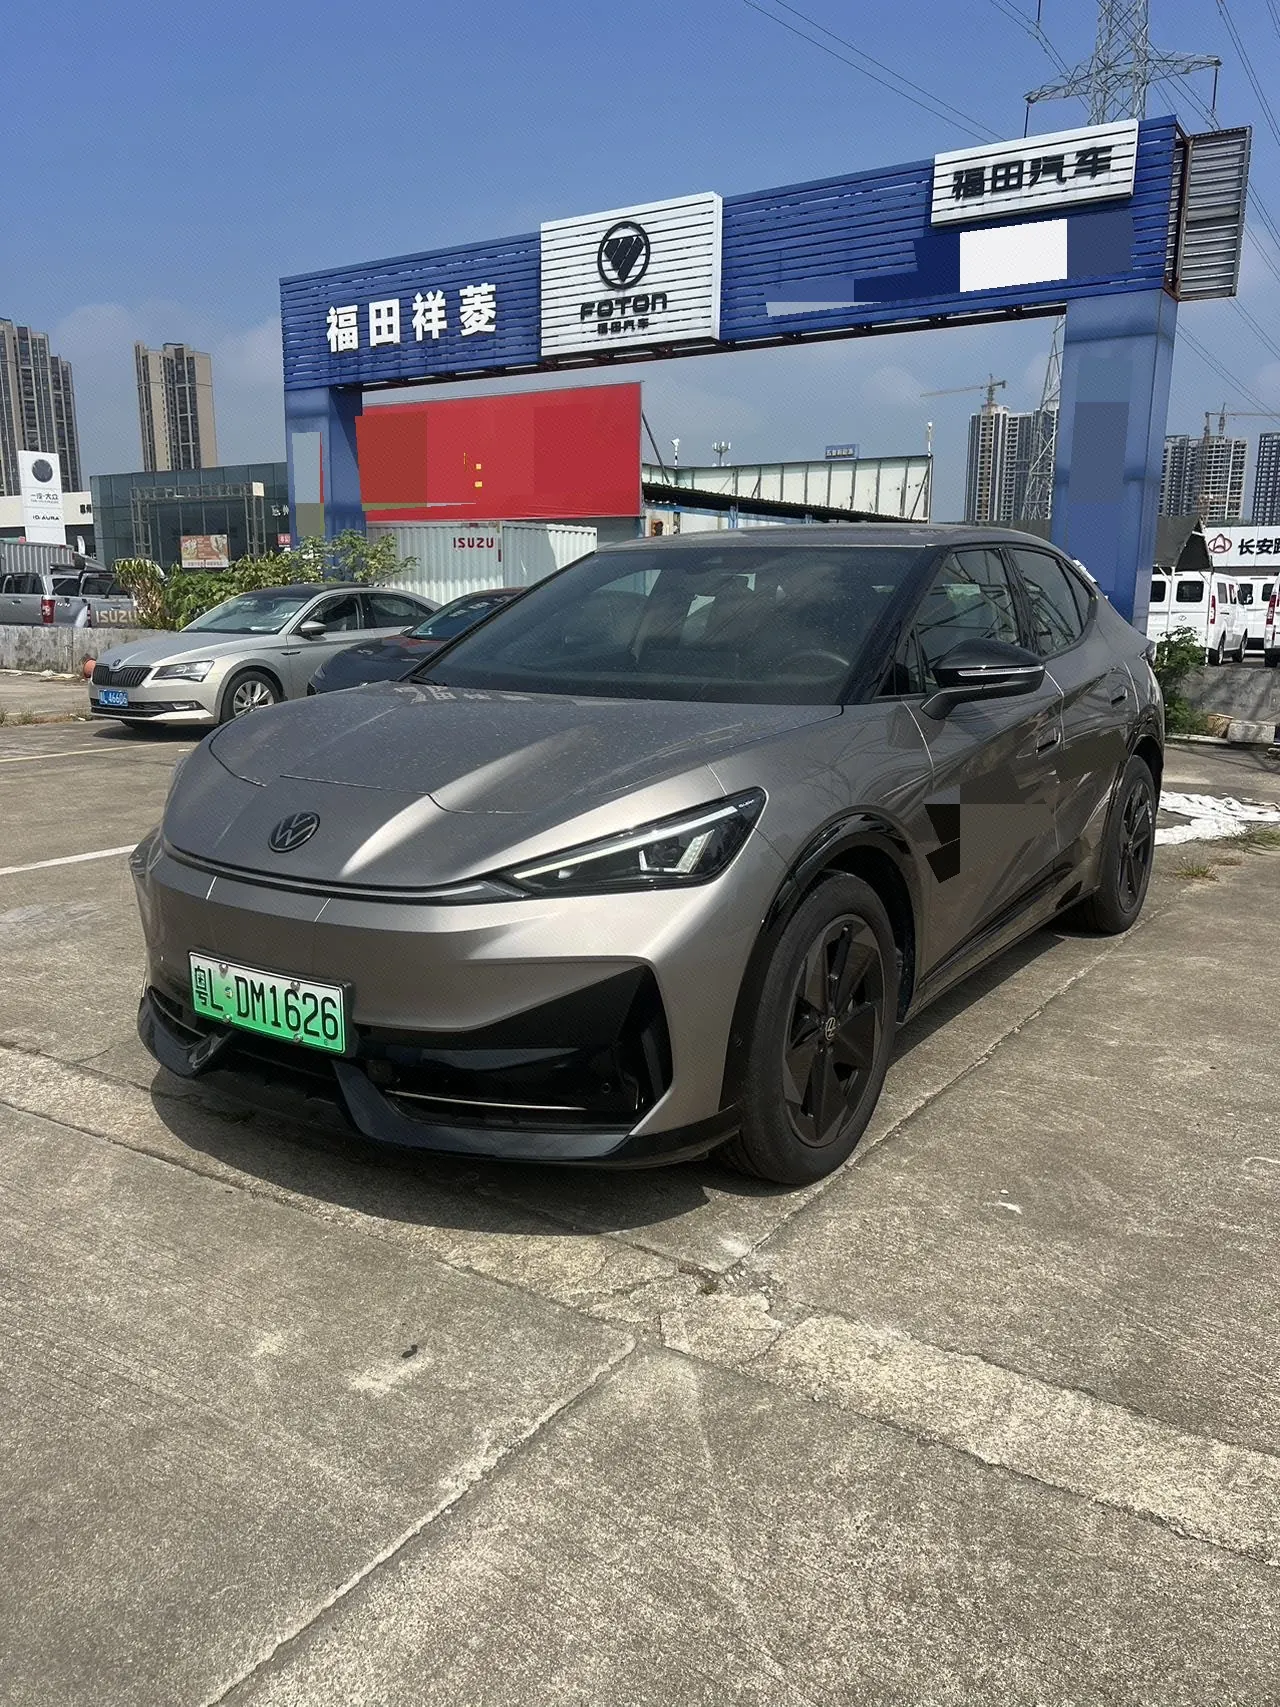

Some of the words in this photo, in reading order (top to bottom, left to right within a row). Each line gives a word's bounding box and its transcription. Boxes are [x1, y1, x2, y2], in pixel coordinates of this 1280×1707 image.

[952, 146, 1112, 200] 福田汽车
[580, 292, 667, 320] FOTON
[326, 283, 497, 352] 福田祥菱
[597, 318, 649, 335] 福田汽车
[453, 537, 494, 548] ISUZU
[96, 610, 137, 623] ISUZU
